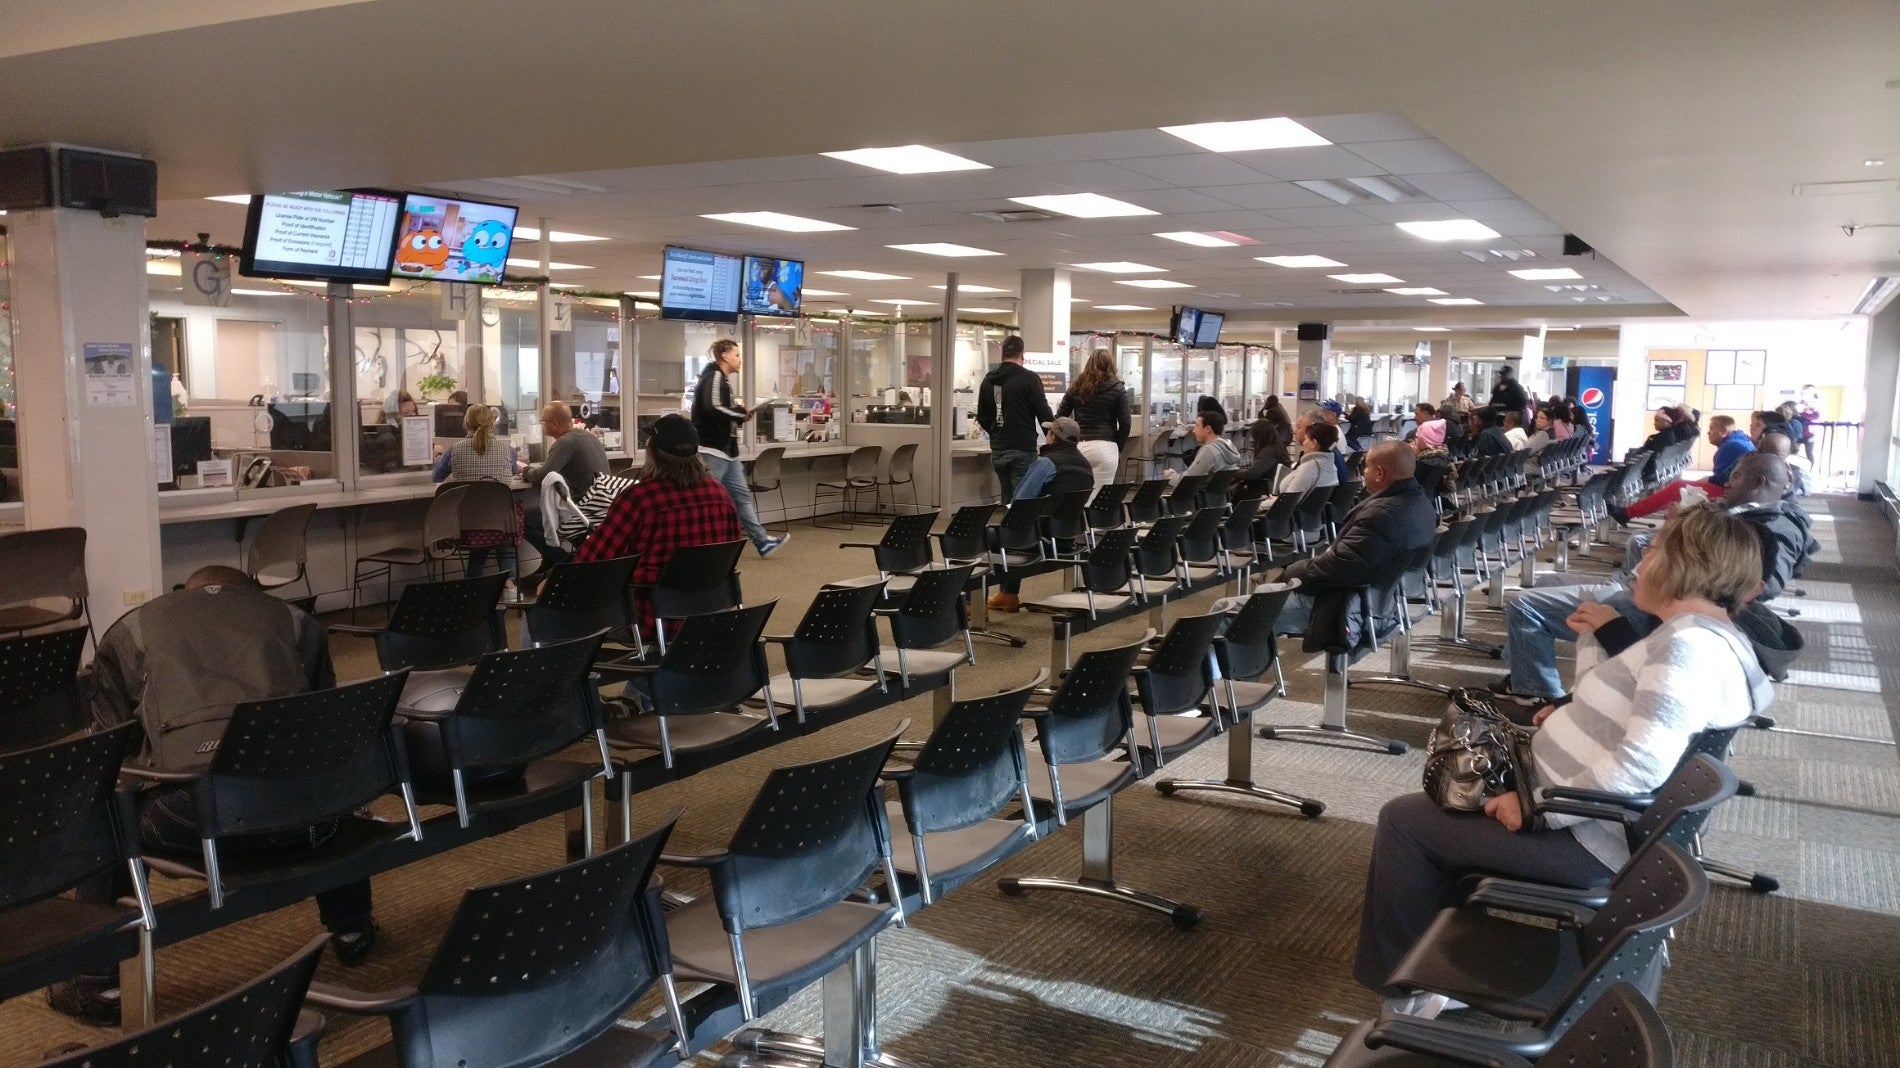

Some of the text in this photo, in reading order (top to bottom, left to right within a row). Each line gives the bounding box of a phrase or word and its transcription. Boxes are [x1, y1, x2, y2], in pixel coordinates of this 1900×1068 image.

[293, 230, 310, 238] Current
[300, 223, 326, 231] Identification
[193, 261, 221, 296] G
[450, 282, 467, 311] H
[798, 321, 808, 340] K
